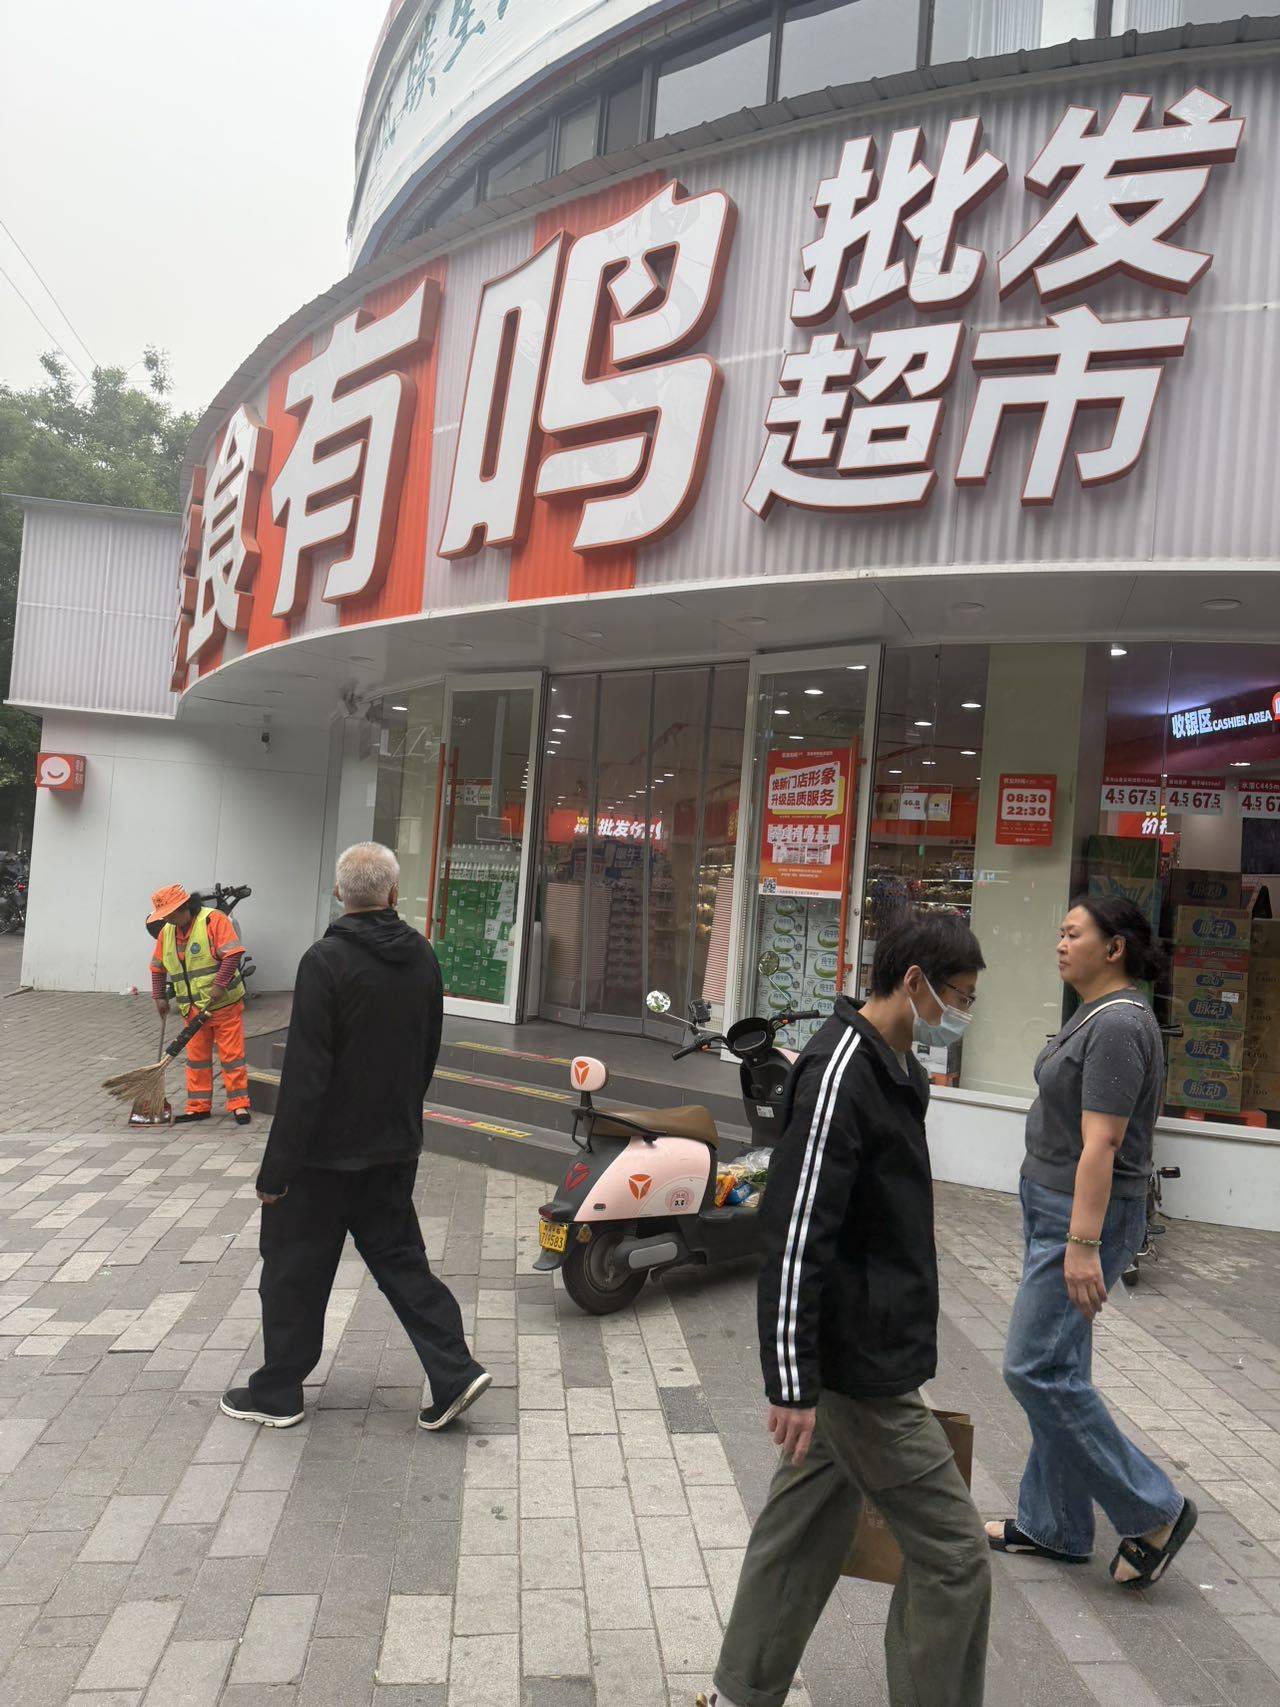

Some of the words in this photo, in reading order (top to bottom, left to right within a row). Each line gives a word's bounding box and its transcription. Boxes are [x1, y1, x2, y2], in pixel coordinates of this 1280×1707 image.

[791, 86, 1246, 326] 批发
[742, 304, 1192, 522] 超市
[170, 178, 738, 692] 食有鸣
[1172, 707, 1214, 738] 收银区
[1212, 715, 1248, 731] CASHIER
[1248, 709, 1273, 725] AREA
[772, 767, 836, 791] 焕新门店形象
[771, 789, 835, 807] 升级品质服务
[1007, 793, 1047, 804] 08:30
[1006, 806, 1047, 816] 22:30
[1197, 918, 1231, 938] 脉动
[1193, 1000, 1228, 1019] 脉动
[1191, 1040, 1224, 1058] 脉动
[1188, 1081, 1221, 1100] 脉动
